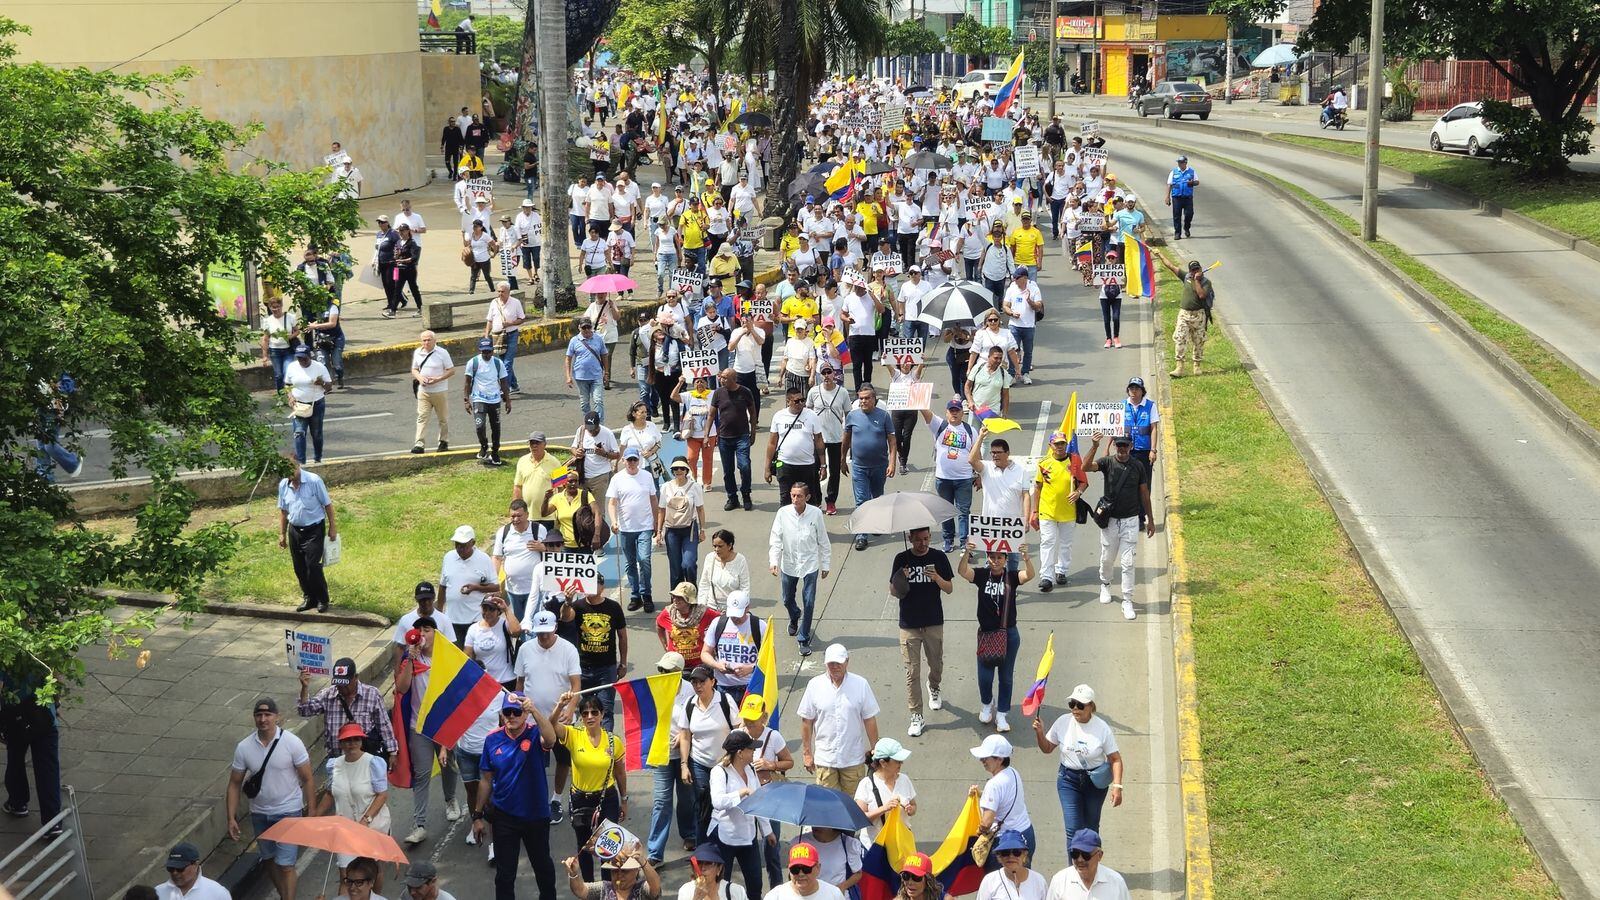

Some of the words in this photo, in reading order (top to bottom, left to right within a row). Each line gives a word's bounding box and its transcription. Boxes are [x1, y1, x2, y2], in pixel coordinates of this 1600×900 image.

[965, 197, 991, 205] FUERA
[966, 203, 992, 211] PETRO
[973, 210, 986, 218] YA
[873, 254, 901, 262] FUERA
[673, 269, 702, 279] FUERA
[672, 276, 701, 286] PETRO
[1100, 277, 1118, 285] YA
[678, 283, 694, 293] YA
[884, 338, 922, 346] FUERA
[681, 349, 717, 360] FUERA
[885, 346, 922, 355] PETRO
[682, 357, 718, 368] PETRO
[893, 354, 915, 364] YA
[690, 366, 712, 378] YA
[1094, 402, 1124, 410] CONGRESO
[1080, 412, 1101, 425] ART.
[1115, 426, 1124, 436] YA
[970, 515, 1024, 527] FUERA
[970, 527, 1023, 539] PETRO
[981, 538, 1013, 553] YA
[544, 552, 596, 565] FUERA
[544, 565, 596, 579] PETRO
[555, 577, 586, 593] YA
[985, 581, 1004, 595] 23N
[302, 642, 322, 654] PETRO
[718, 644, 758, 654] FUERA
[720, 654, 757, 663] PETRO
[600, 836, 618, 848] FUERA
[600, 841, 617, 854] PETRO
